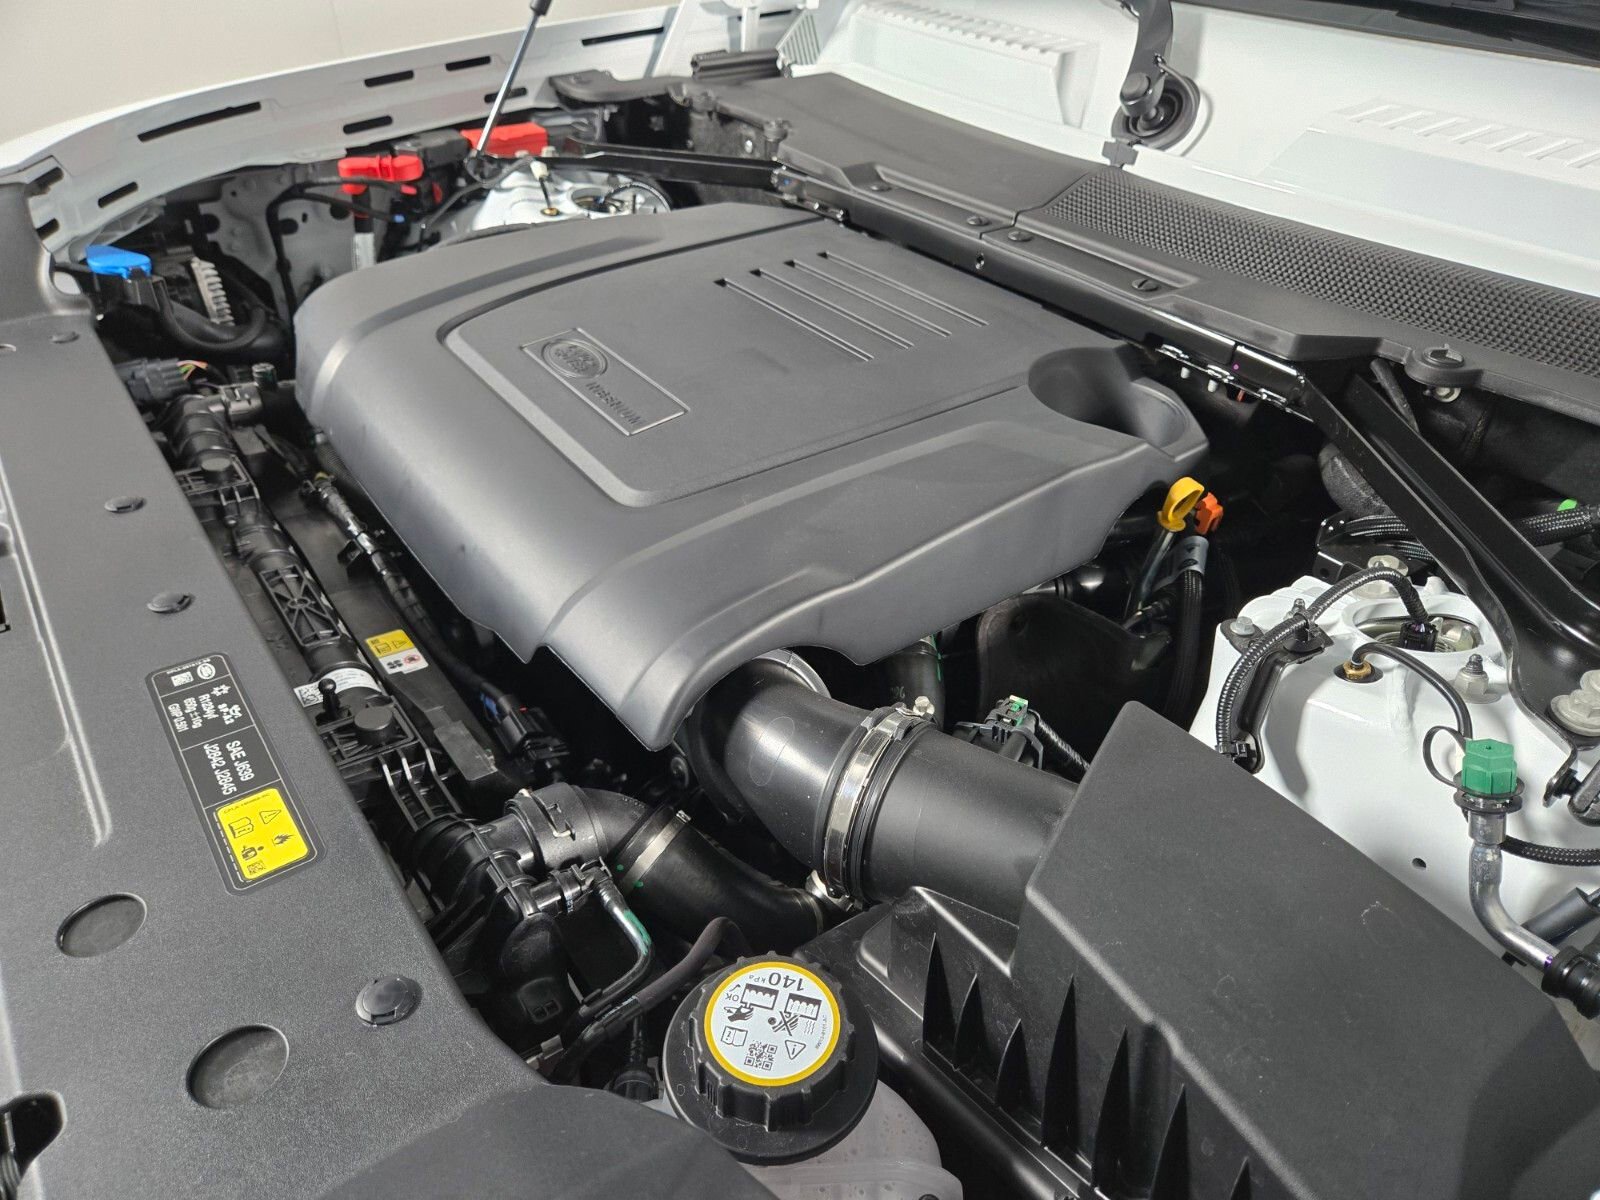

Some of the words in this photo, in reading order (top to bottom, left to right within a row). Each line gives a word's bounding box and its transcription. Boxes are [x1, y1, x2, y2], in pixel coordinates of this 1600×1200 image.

[168, 703, 184, 718] GWP
[198, 693, 219, 719] R1234yf
[203, 743, 226, 769] J2842
[225, 740, 246, 760] SAE
[234, 760, 255, 782] J639
[214, 769, 237, 795] J2845
[748, 974, 767, 984] kPa
[768, 972, 805, 991] 140
[725, 992, 740, 1002] OK
